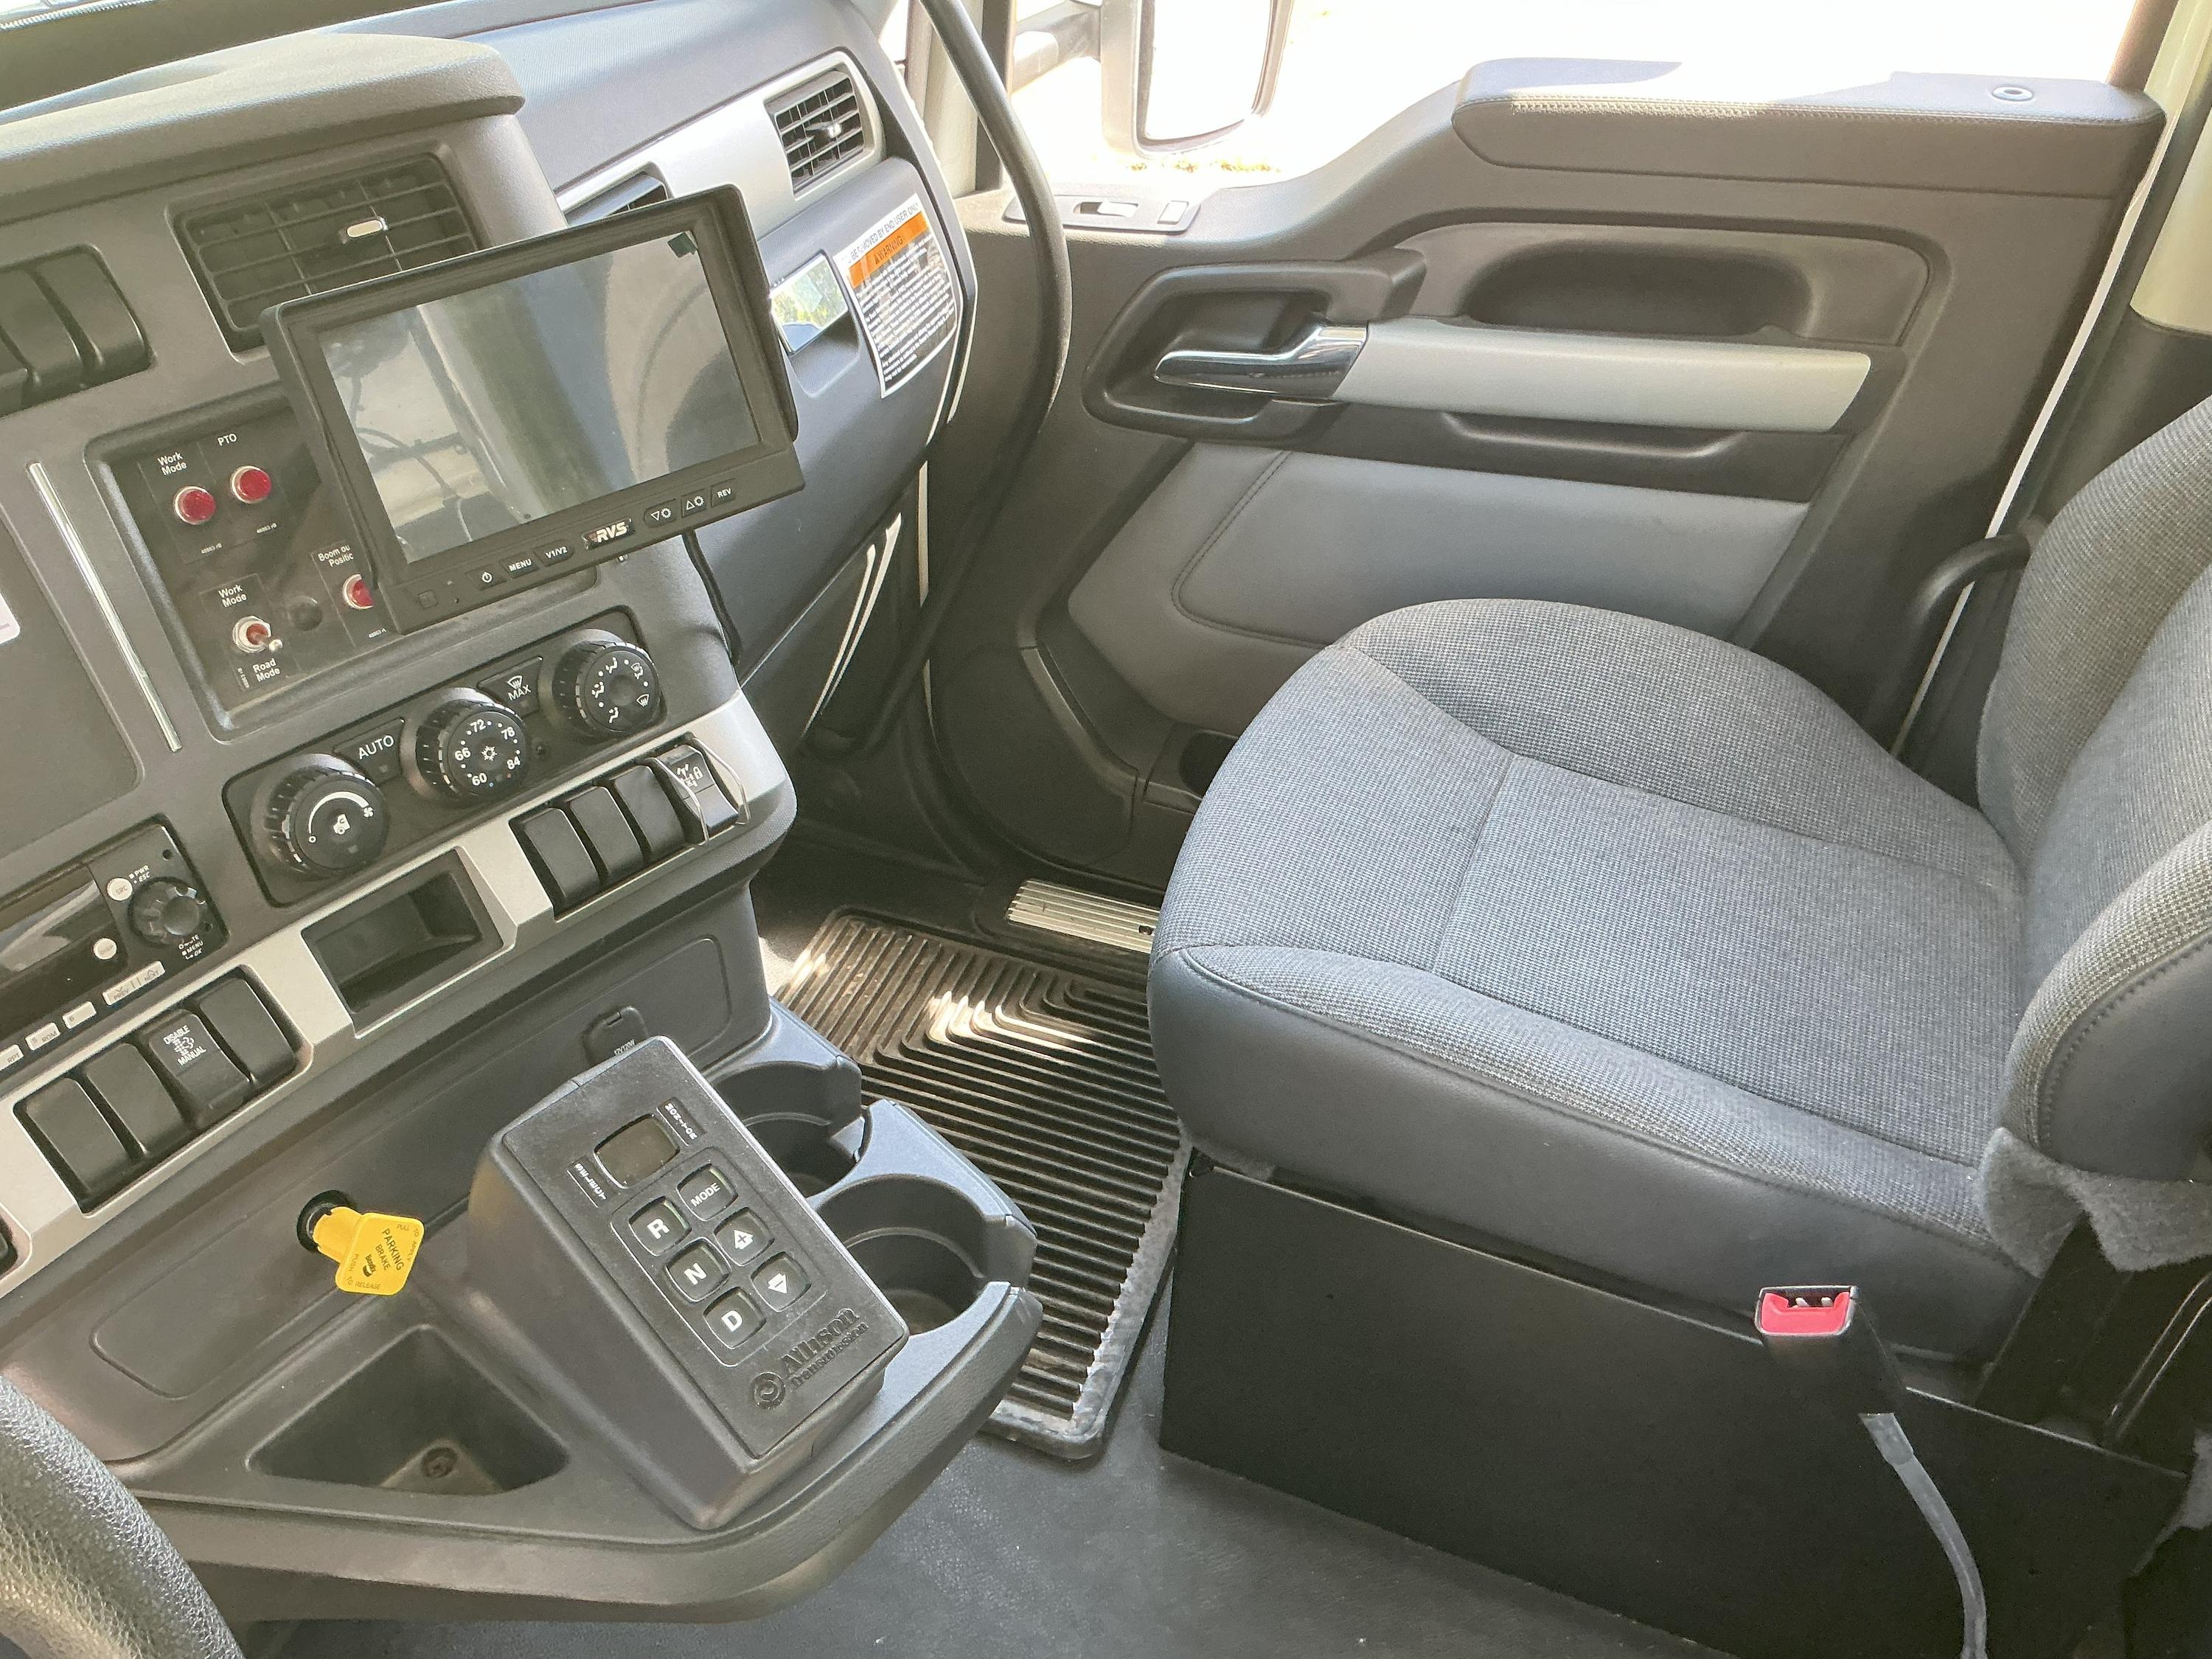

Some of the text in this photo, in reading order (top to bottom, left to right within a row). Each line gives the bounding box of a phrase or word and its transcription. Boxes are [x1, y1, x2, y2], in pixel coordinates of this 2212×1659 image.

[858, 232, 879, 253] RMOVED
[877, 227, 886, 238] BY
[884, 219, 895, 233] END
[894, 209, 908, 225] USER
[877, 235, 903, 260] WARNING
[217, 433, 237, 446] PTO
[157, 451, 184, 466] Work
[161, 461, 187, 476] Mode
[717, 487, 732, 498] REV
[596, 521, 627, 543] RVS
[317, 548, 341, 562] Boom
[329, 552, 354, 568] Positio
[545, 546, 568, 559] V1/V2
[509, 558, 532, 572] MENU
[218, 584, 243, 599] Work
[221, 593, 247, 608] Mode
[252, 658, 276, 673] Road
[256, 667, 281, 682] Mode
[507, 684, 532, 701] MAX
[470, 718, 487, 733] 72
[501, 726, 515, 740] 78
[358, 735, 394, 760] AUTO
[454, 747, 471, 761] 66
[507, 756, 521, 770] 84
[471, 772, 487, 786] 60
[134, 865, 150, 877] PWR
[139, 872, 151, 882] ESC
[187, 940, 204, 953] MENU
[163, 1025, 190, 1045] DISABLE
[7, 1052, 20, 1063] RPT
[177, 1046, 206, 1066] MANUAL
[664, 1102, 698, 1141] MONITOR
[575, 1163, 607, 1200] SELECT
[690, 1182, 720, 1207] MODE
[397, 1223, 410, 1232] PULL
[413, 1228, 420, 1237] TO
[647, 1218, 669, 1239] R
[375, 1244, 392, 1270] BRAKE
[381, 1228, 405, 1271] PARKING
[684, 1262, 707, 1285] N
[347, 1276, 353, 1286] TO
[355, 1281, 381, 1290] RELEASE
[720, 1310, 742, 1332] D
